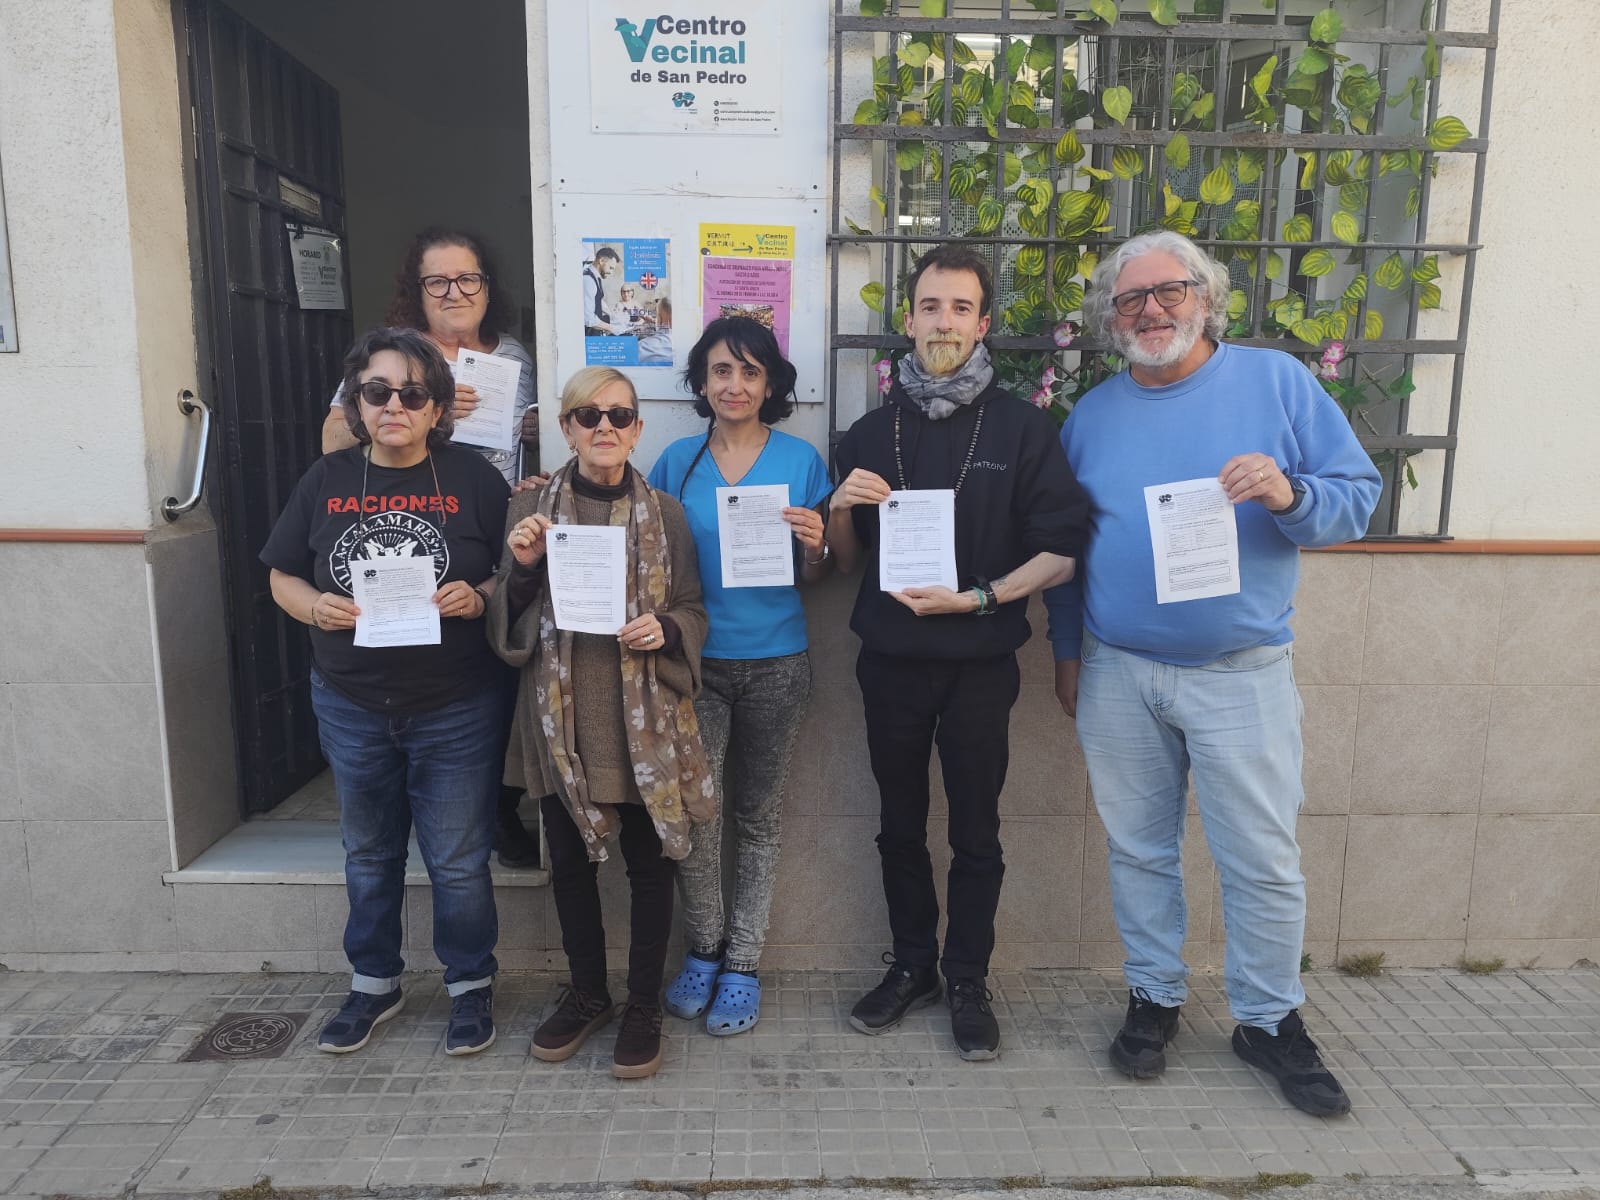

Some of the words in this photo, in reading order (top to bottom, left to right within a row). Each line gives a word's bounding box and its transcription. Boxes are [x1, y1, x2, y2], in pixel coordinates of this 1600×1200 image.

[656, 14, 746, 36] Centro
[614, 17, 746, 64] Vecinal
[630, 69, 652, 83] de
[657, 70, 690, 84] San
[696, 70, 747, 85] Pedro
[327, 495, 460, 515] RACIONES
[341, 514, 439, 547] CALAMARES
